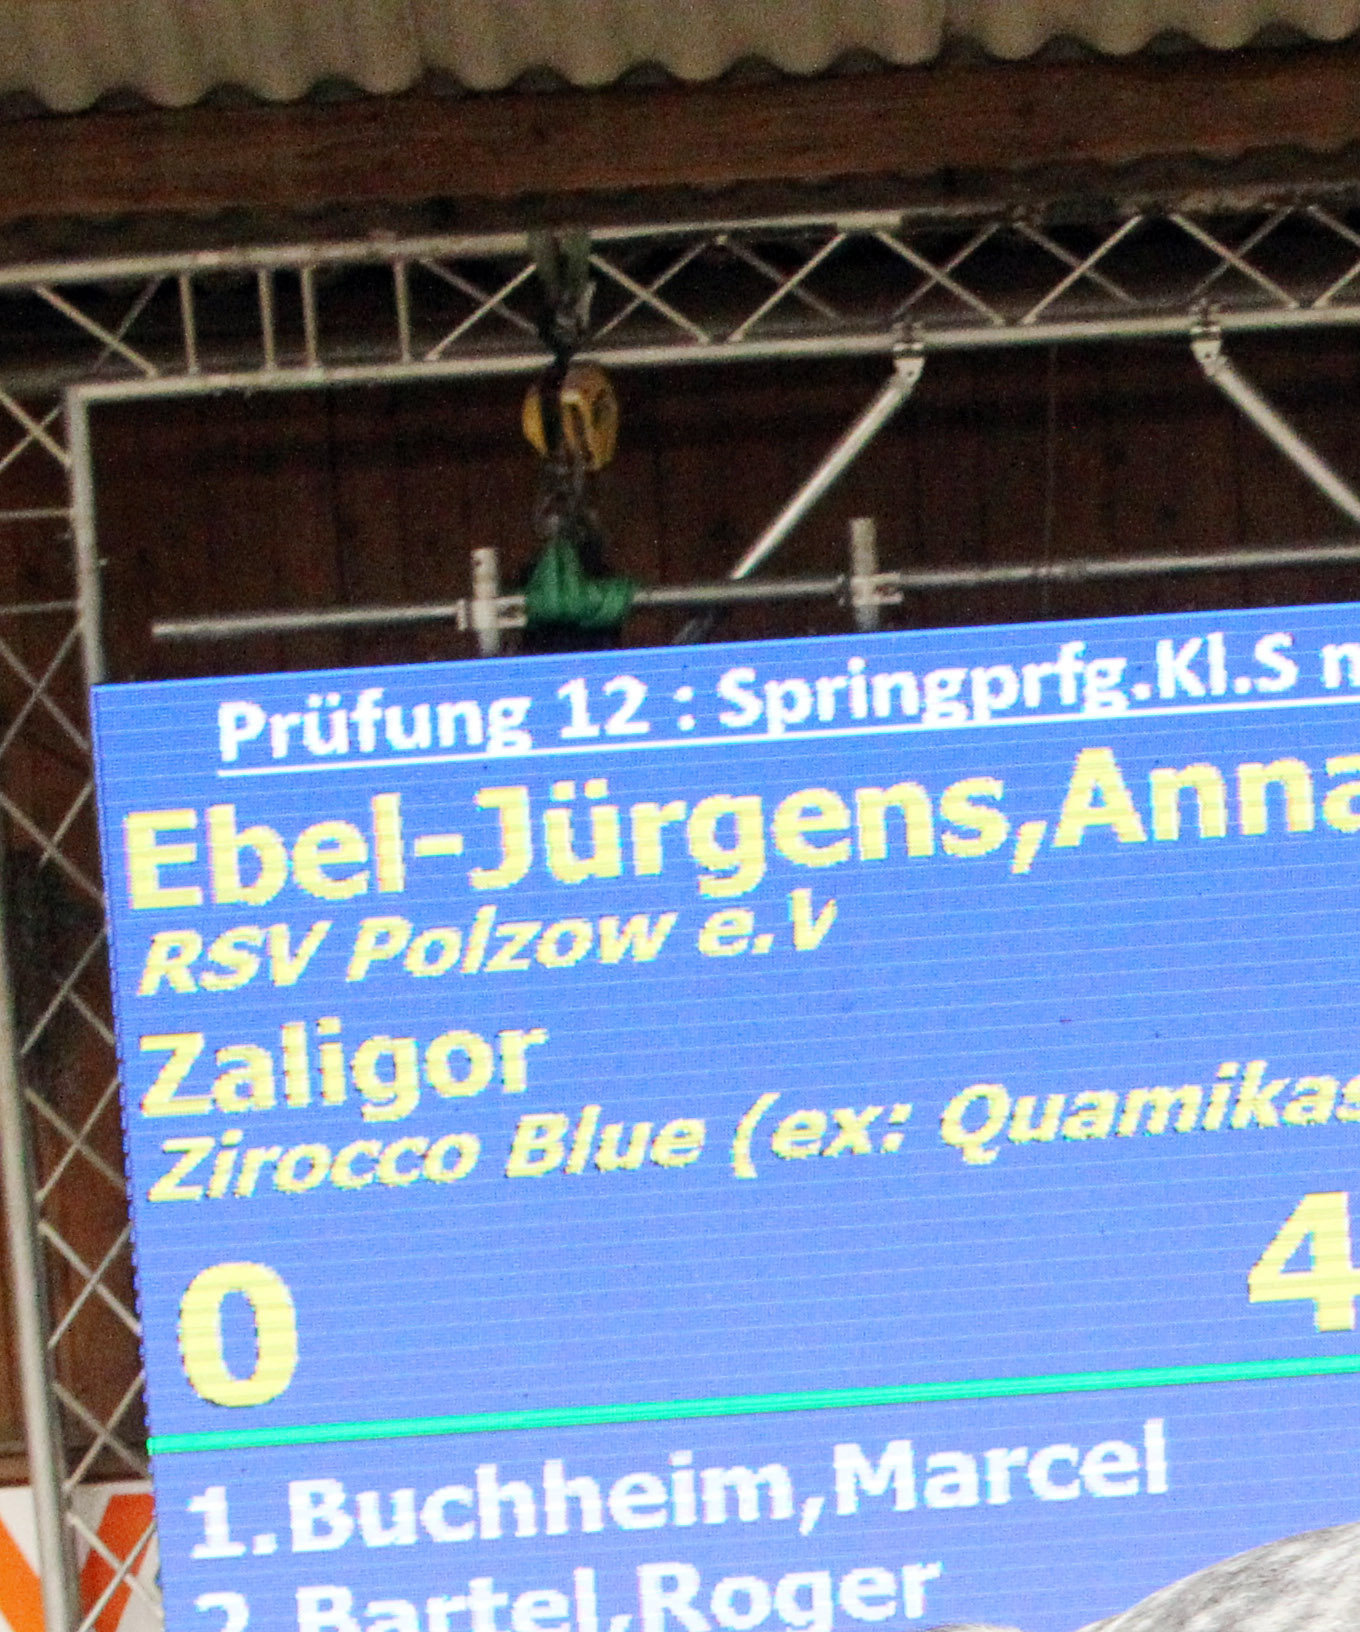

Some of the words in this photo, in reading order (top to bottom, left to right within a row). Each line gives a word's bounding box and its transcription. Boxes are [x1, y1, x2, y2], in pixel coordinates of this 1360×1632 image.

[218, 687, 533, 756] Prüfung
[557, 675, 650, 738] 12
[717, 632, 1298, 735] Springprfg.Kl.S
[137, 919, 332, 997] RSV
[345, 904, 678, 983] Polzow
[697, 887, 838, 959] e.V
[139, 1016, 549, 1124] Zaligor
[148, 1132, 481, 1203] Zirocco
[505, 1103, 707, 1180] Blue
[731, 1091, 911, 1179] (ex:
[177, 1261, 299, 1407] 0
